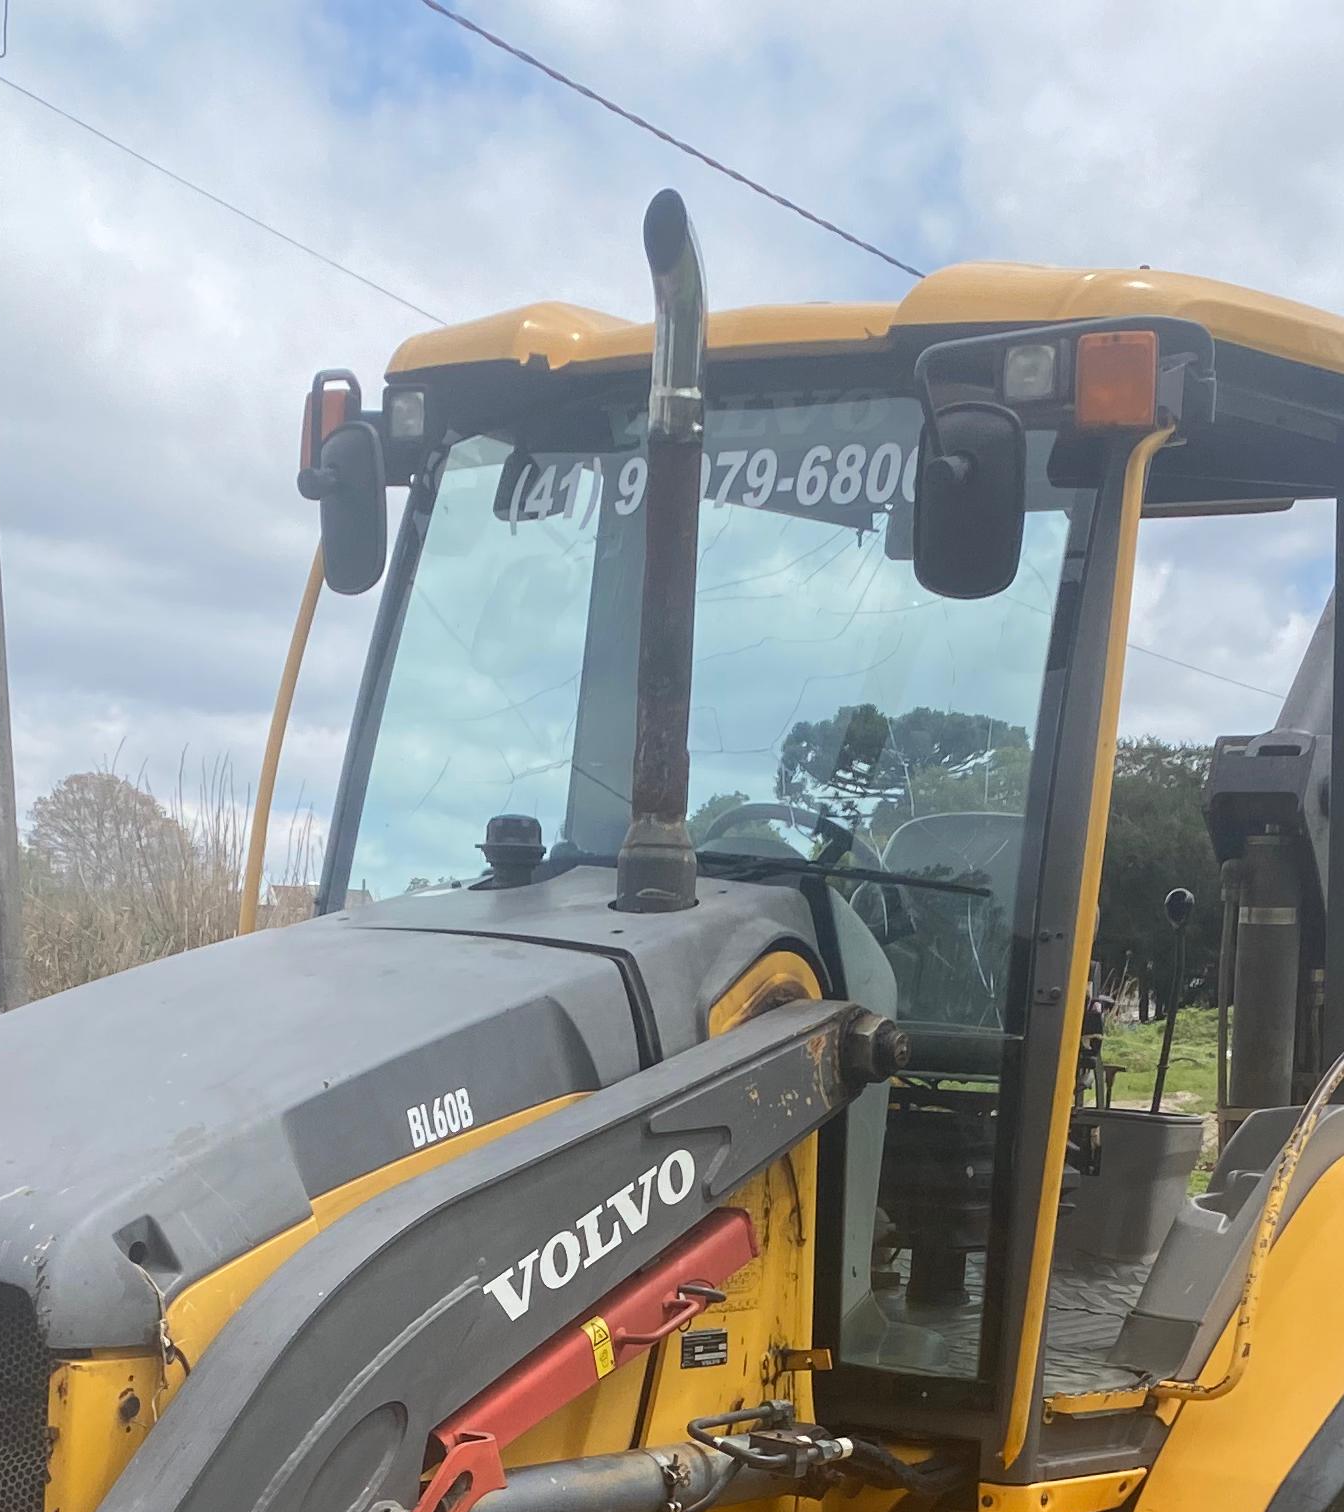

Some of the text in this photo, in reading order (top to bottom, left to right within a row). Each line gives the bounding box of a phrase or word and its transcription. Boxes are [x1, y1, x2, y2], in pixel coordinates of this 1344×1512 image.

[510, 443, 918, 536] (41) 979-680
[407, 1088, 474, 1148] BL60B
[483, 1149, 695, 1321] VOLVO
